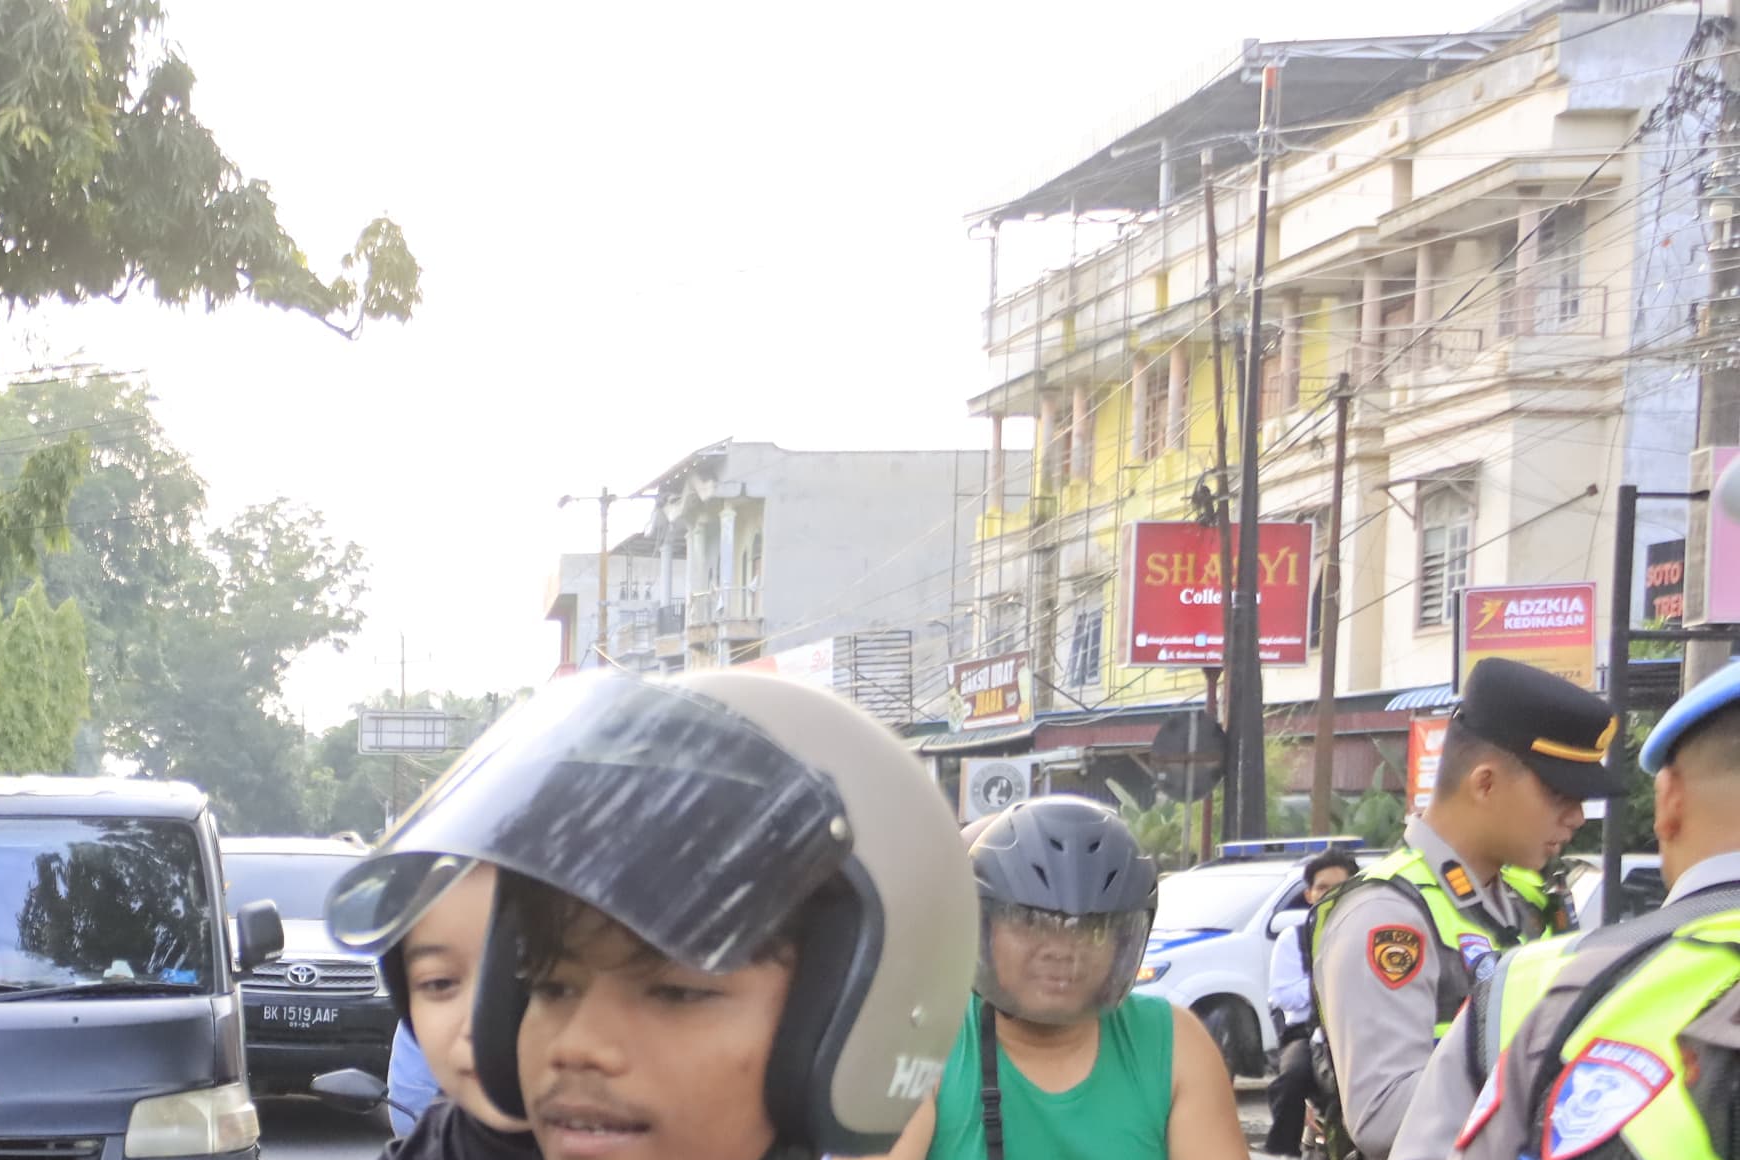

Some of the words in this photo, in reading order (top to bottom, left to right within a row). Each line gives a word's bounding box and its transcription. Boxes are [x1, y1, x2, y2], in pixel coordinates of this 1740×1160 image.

[1504, 596, 1585, 616] ADZKIA
[1504, 614, 1586, 630] KEDINASAN
[264, 1006, 278, 1021] BK
[283, 1006, 311, 1021] 1519
[312, 1008, 339, 1024] AAF
